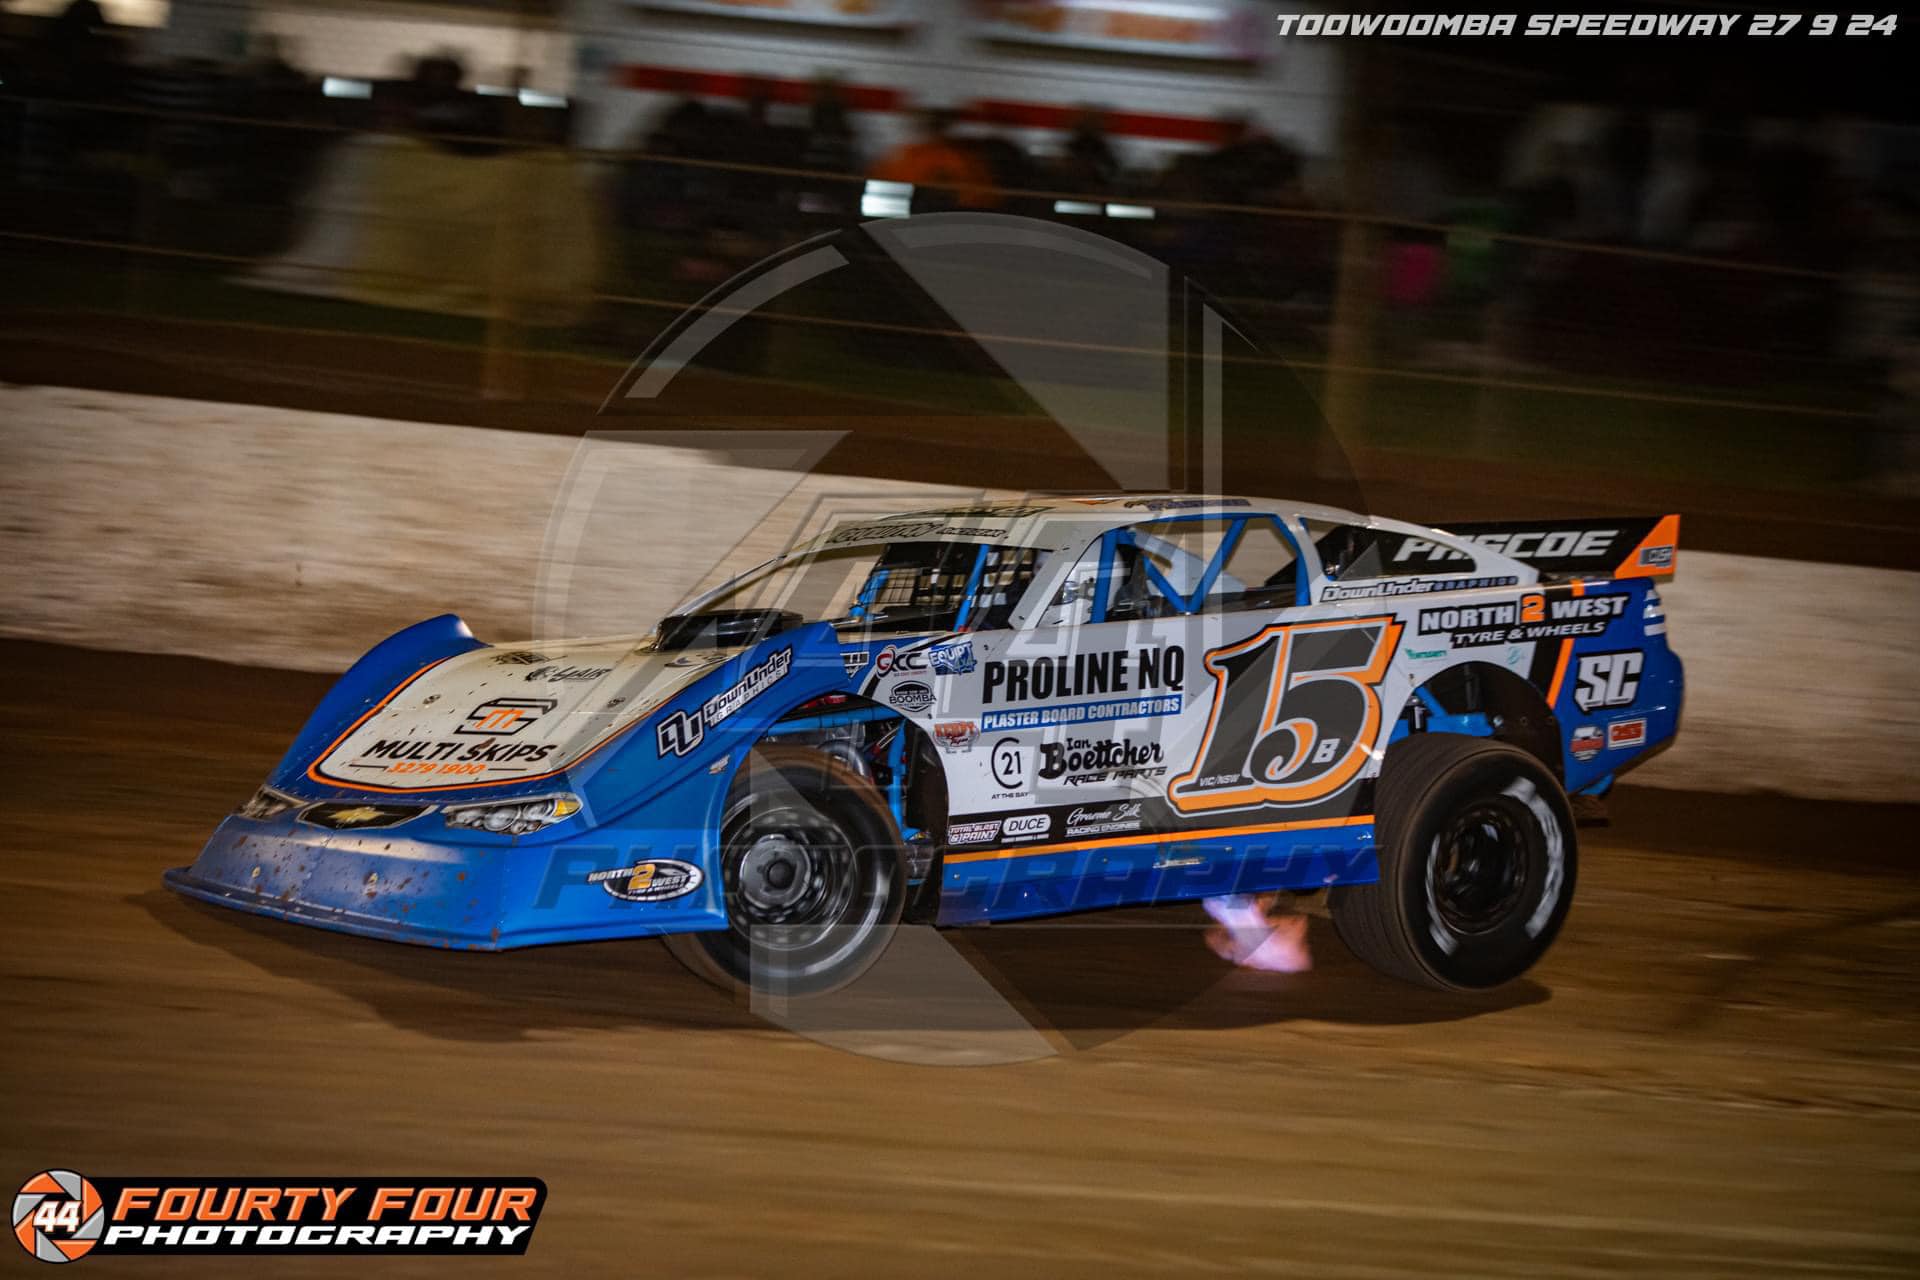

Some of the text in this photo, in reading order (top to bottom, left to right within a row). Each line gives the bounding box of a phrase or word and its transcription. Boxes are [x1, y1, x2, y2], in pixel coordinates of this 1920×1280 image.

[1421, 594, 1628, 632] NORTH 2 WEST
[1455, 622, 1606, 645] TYRE & WHEELS
[704, 648, 792, 720] DownUnder
[982, 645, 1184, 704] PROLINE NQ
[1575, 652, 1643, 711] SC
[889, 693, 938, 704] BOOMBA
[983, 711, 1039, 729] PLASTER
[1042, 707, 1085, 724] BOARD
[1087, 699, 1179, 718] CONTRACTORS
[1168, 614, 1405, 815] 15
[361, 740, 557, 763] MULTI SKIPS
[1066, 738, 1091, 751] Ian
[1038, 739, 1164, 780] Boettcher
[1063, 766, 1168, 787] RACE PARTS
[1008, 817, 1047, 832] DUCE
[588, 868, 633, 882] NORTH
[628, 863, 656, 890] 2
